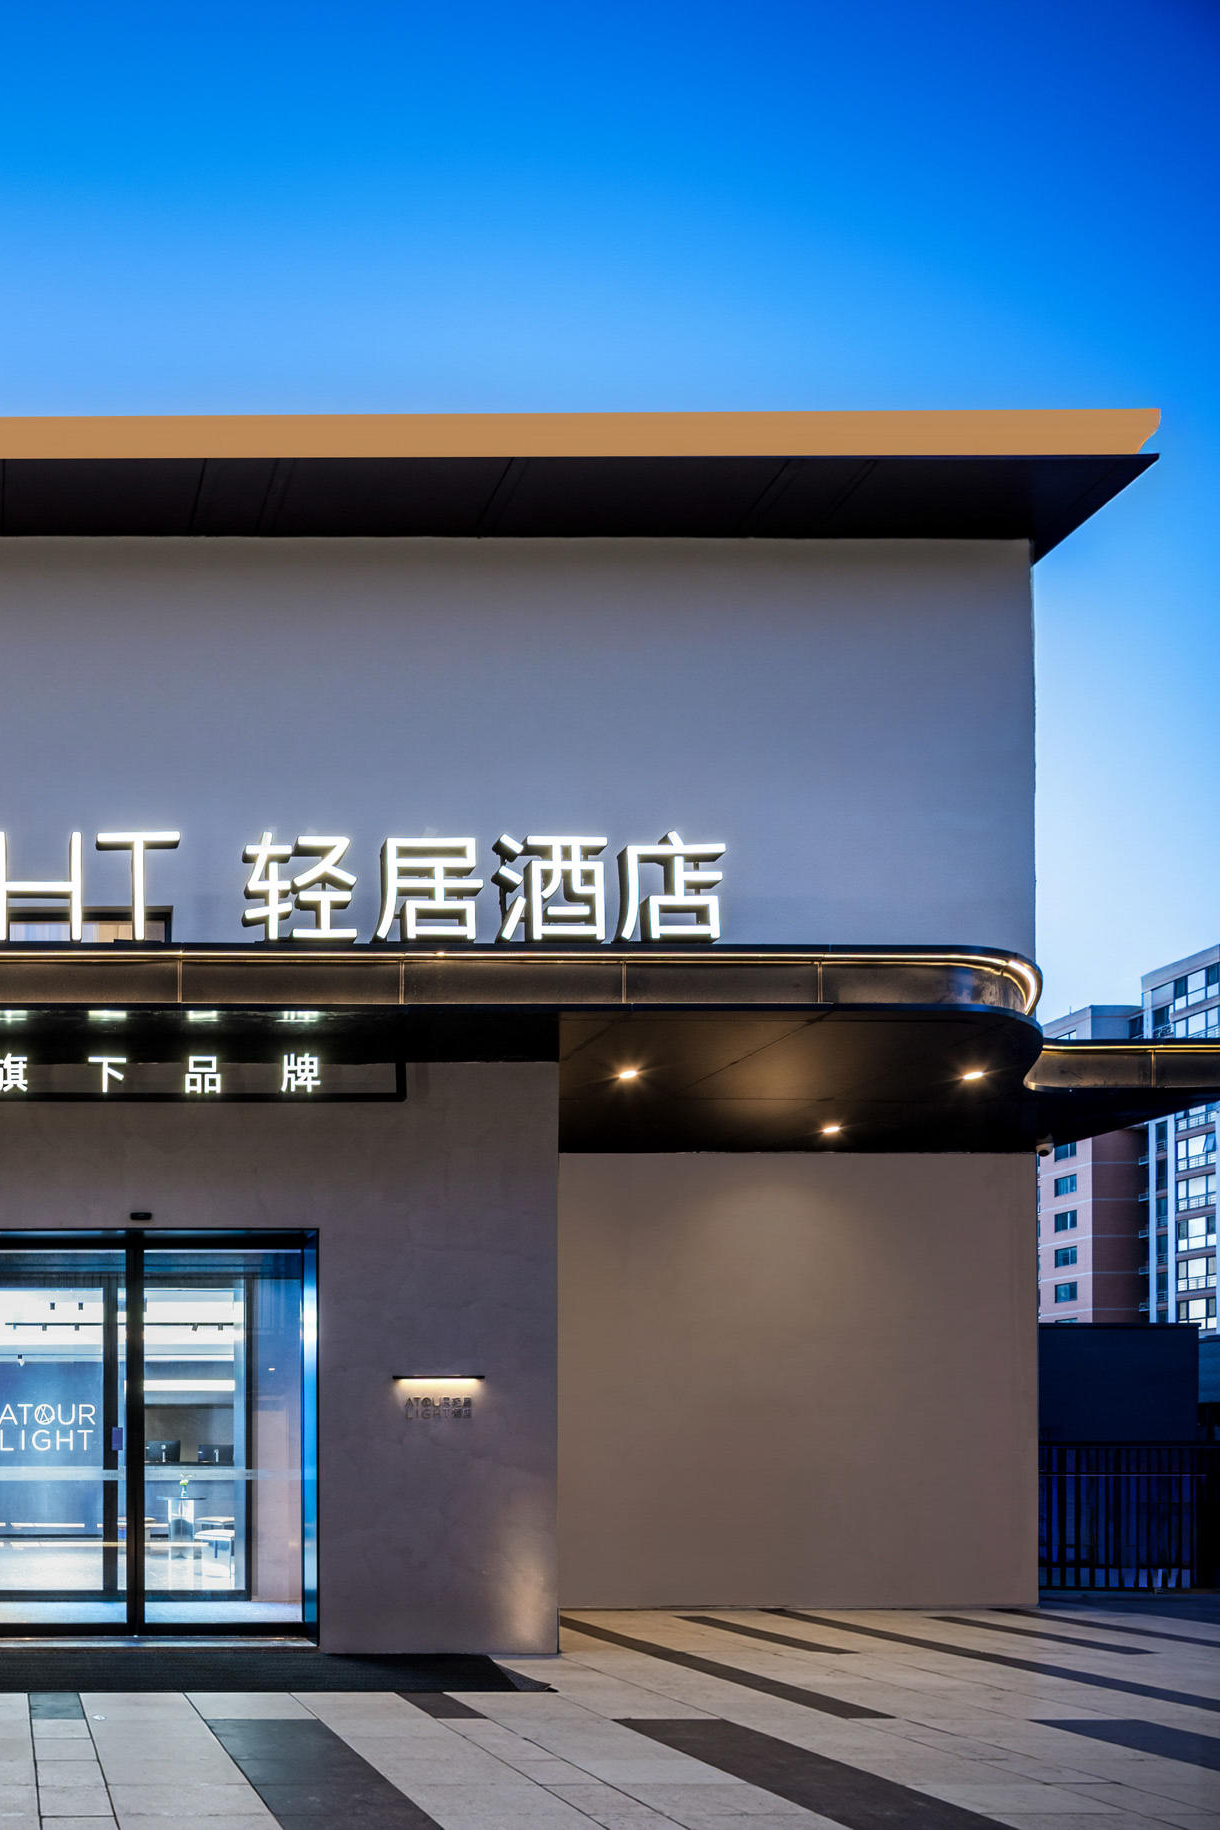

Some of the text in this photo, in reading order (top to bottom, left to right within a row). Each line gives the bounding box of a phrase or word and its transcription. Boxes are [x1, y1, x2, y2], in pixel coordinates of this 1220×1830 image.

[244, 831, 726, 941] 轻居酒店
[405, 1409, 449, 1419] LIGHT
[0, 1429, 93, 1451] LIGHT
